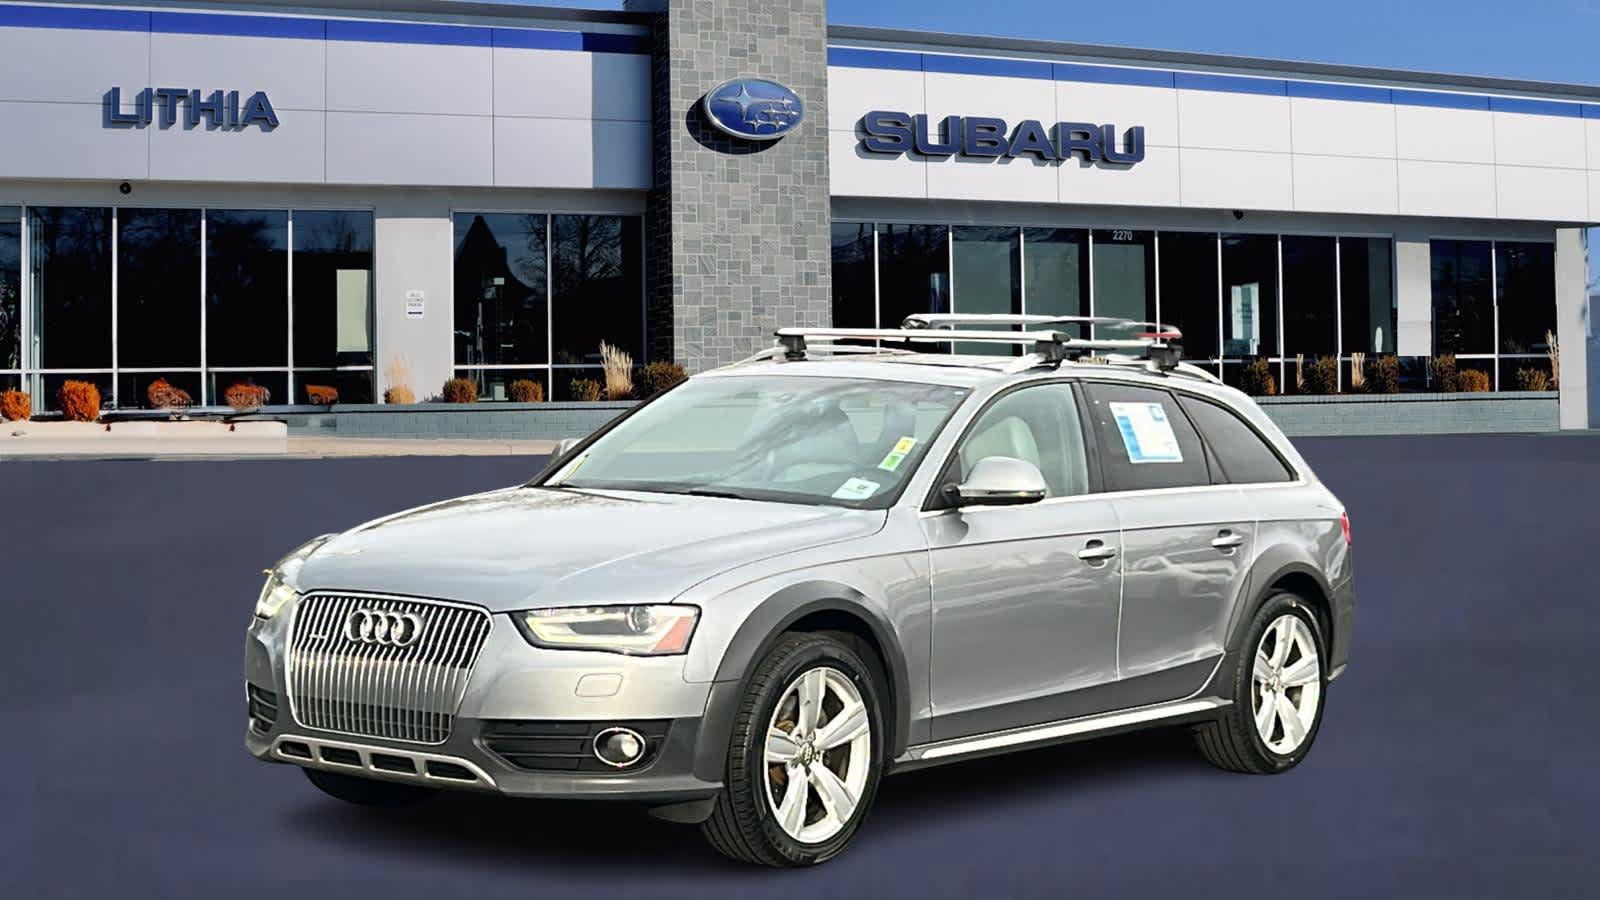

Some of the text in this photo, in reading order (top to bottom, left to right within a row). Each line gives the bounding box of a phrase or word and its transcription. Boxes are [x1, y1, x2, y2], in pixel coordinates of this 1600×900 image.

[107, 86, 280, 129] LITHIA
[861, 110, 1145, 165] SUBARU
[1112, 230, 1133, 241] 2270
